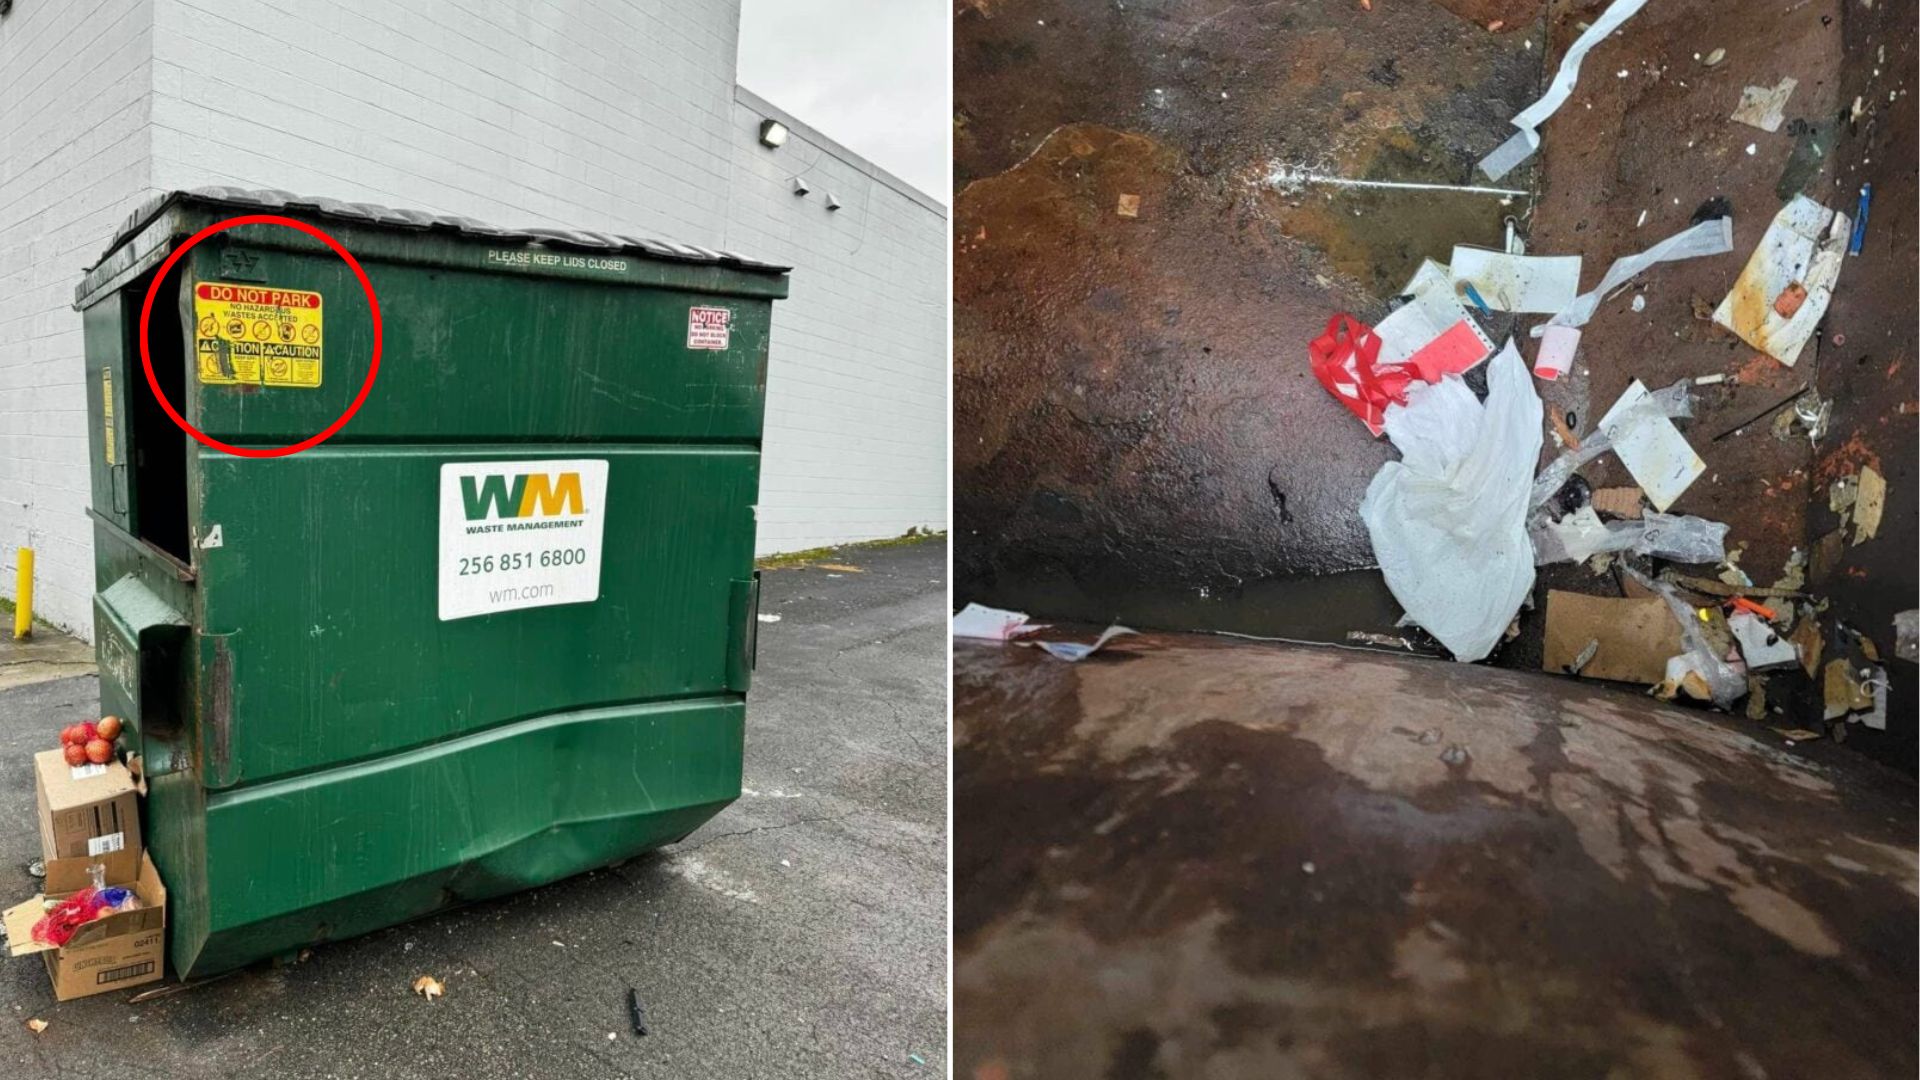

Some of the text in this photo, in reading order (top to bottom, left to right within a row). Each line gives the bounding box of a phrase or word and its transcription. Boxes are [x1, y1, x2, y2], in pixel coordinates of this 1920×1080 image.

[488, 250, 627, 271] PLEASE KEEP LIDS CLOSED
[210, 287, 311, 307] DO NOT PARK
[223, 310, 256, 319] WASTES
[244, 304, 292, 314] HAZARDUS
[692, 310, 727, 324] NOTICE
[211, 340, 260, 354] CTION
[274, 345, 319, 357] CAUTION
[459, 472, 585, 521] WM
[466, 519, 584, 534] WASTE MANAGEMENT
[459, 548, 586, 576] 256 851 6800
[489, 583, 554, 604] wm.com
